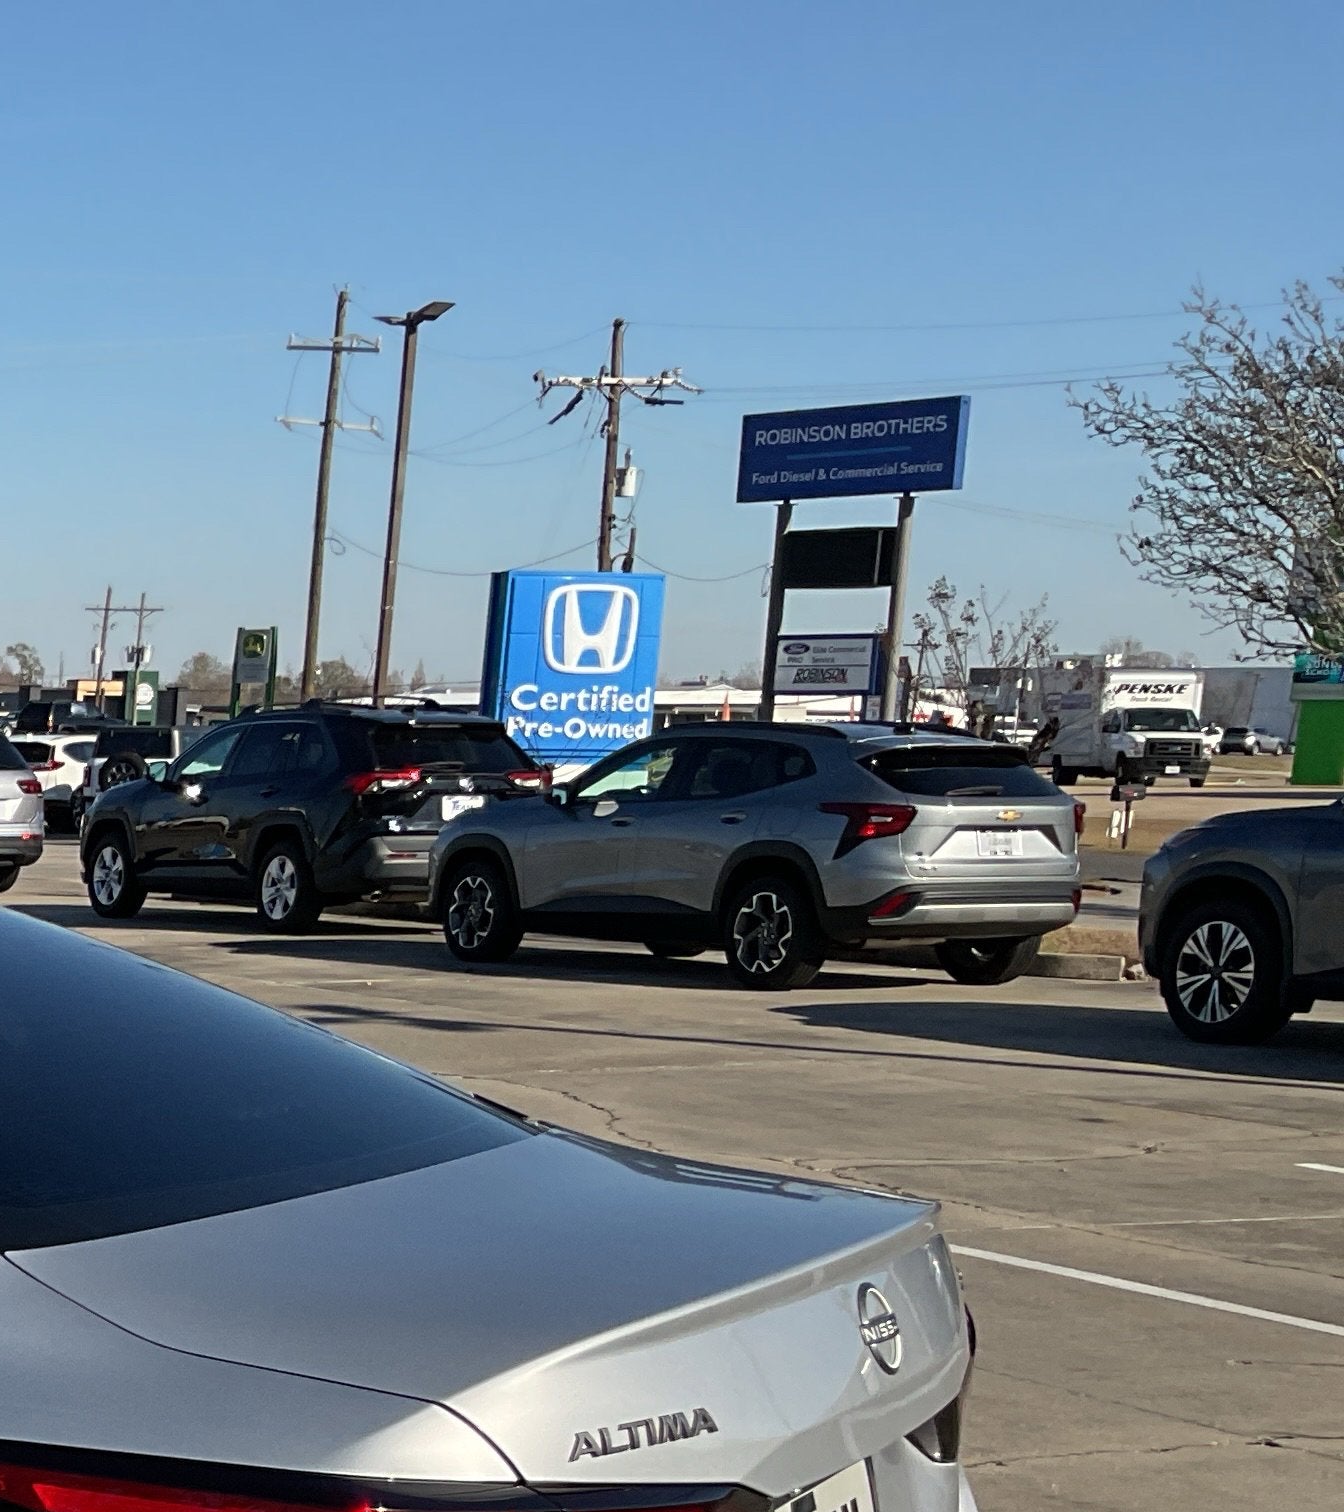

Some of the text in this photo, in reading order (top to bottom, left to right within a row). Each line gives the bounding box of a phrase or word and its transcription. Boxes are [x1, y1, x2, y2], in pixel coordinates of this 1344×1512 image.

[755, 415, 948, 447] ROBINSON BROTHERS
[752, 461, 944, 485] Ford Diesel & Commercial Service
[511, 684, 652, 713] Certified
[1115, 683, 1189, 695] PENSKE
[506, 716, 649, 739] Pre-Owned
[568, 1407, 719, 1463] ALTIMA
